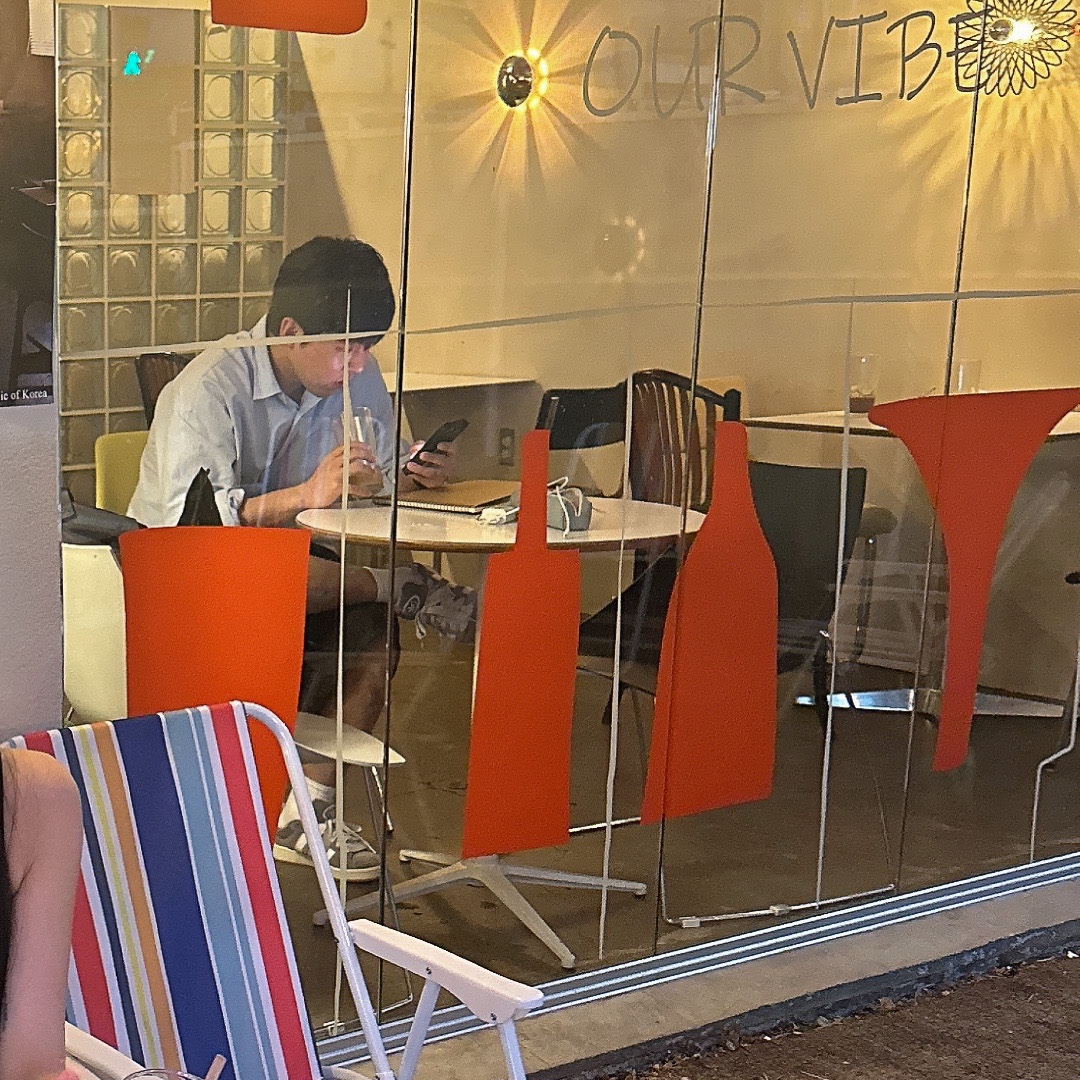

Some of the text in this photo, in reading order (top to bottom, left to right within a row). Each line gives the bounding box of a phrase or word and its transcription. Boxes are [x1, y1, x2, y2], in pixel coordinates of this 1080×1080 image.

[582, 7, 995, 119] OUR VIBE
[10, 388, 21, 401] of
[21, 388, 49, 401] Korea
